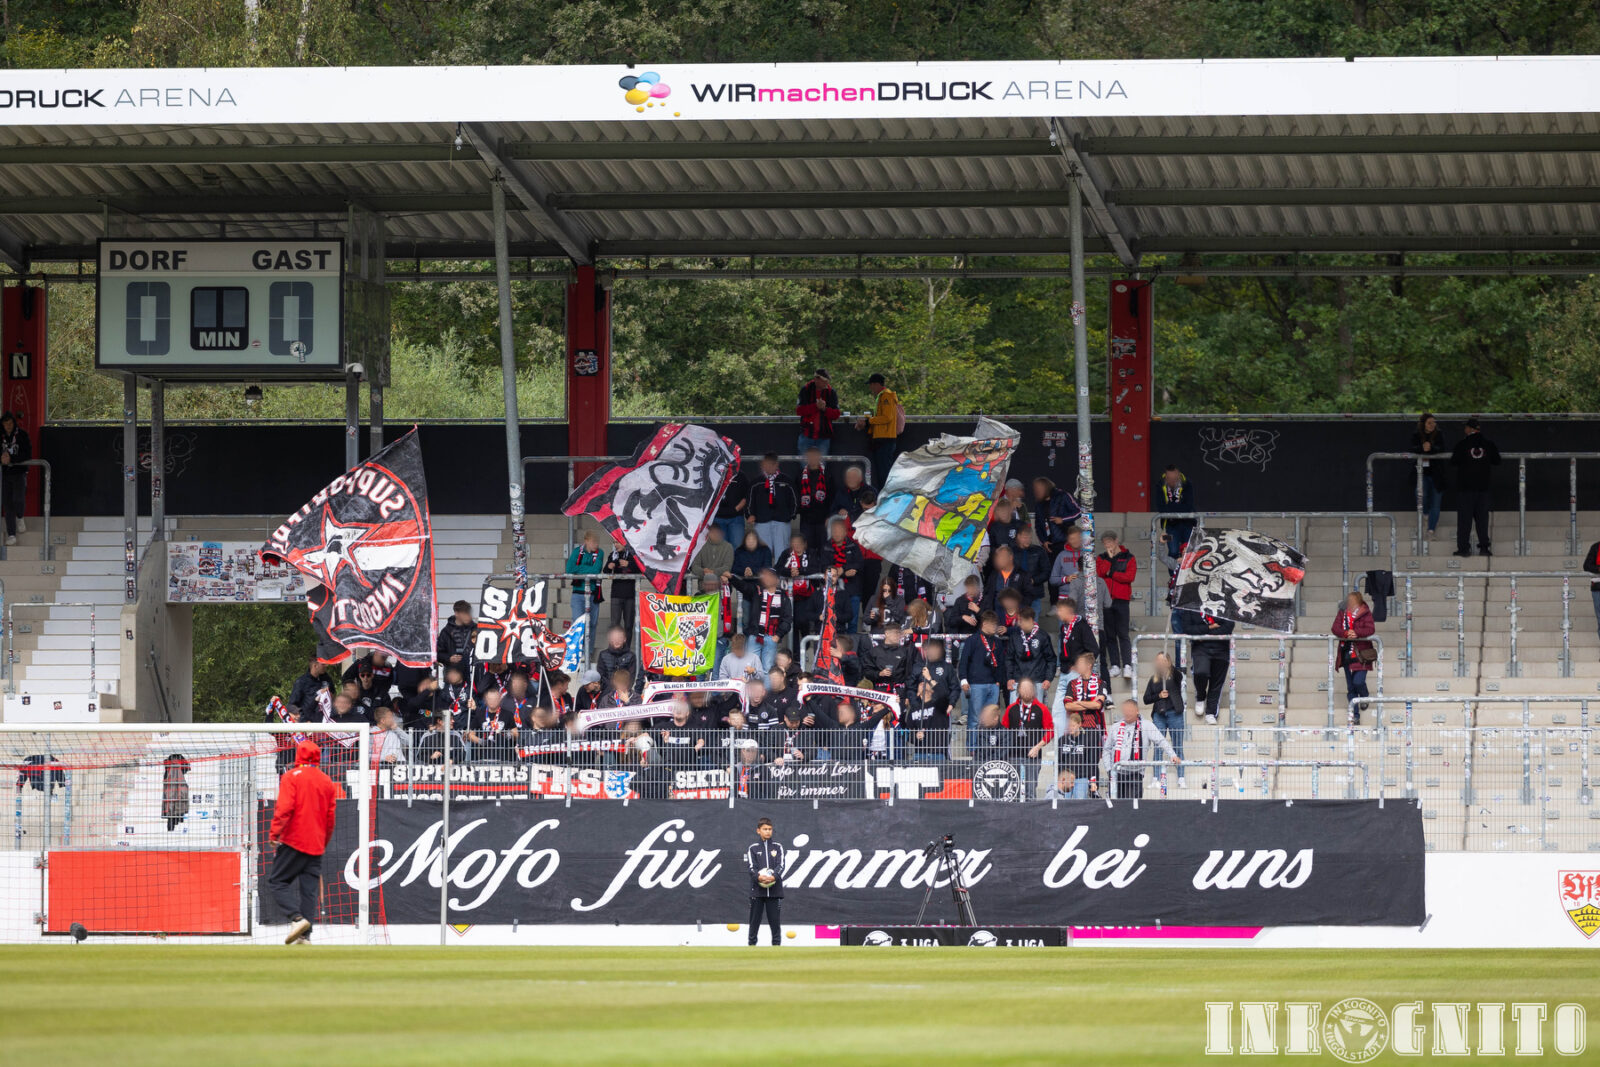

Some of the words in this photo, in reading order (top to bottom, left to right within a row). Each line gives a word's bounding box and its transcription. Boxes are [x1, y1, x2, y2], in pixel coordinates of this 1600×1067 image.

[114, 88, 238, 107] ARENA
[691, 81, 993, 103] WIRmachenDRUCK
[1002, 80, 1129, 101] ARENA
[109, 250, 188, 270] DORF
[252, 250, 332, 270] GAST
[199, 332, 240, 347] MIN
[646, 594, 709, 613] Schanzer
[648, 647, 706, 674] Lifestyle
[806, 684, 842, 694] SUPPORTERS
[856, 689, 890, 702] INGOLSTADT
[393, 765, 528, 783] SUPPORTERS
[798, 762, 828, 776] und
[800, 784, 848, 797] immer
[345, 818, 561, 912] Mofo
[571, 819, 722, 912] für
[782, 834, 993, 890] immer
[1043, 826, 1150, 890] bei
[1193, 849, 1314, 891] uns
